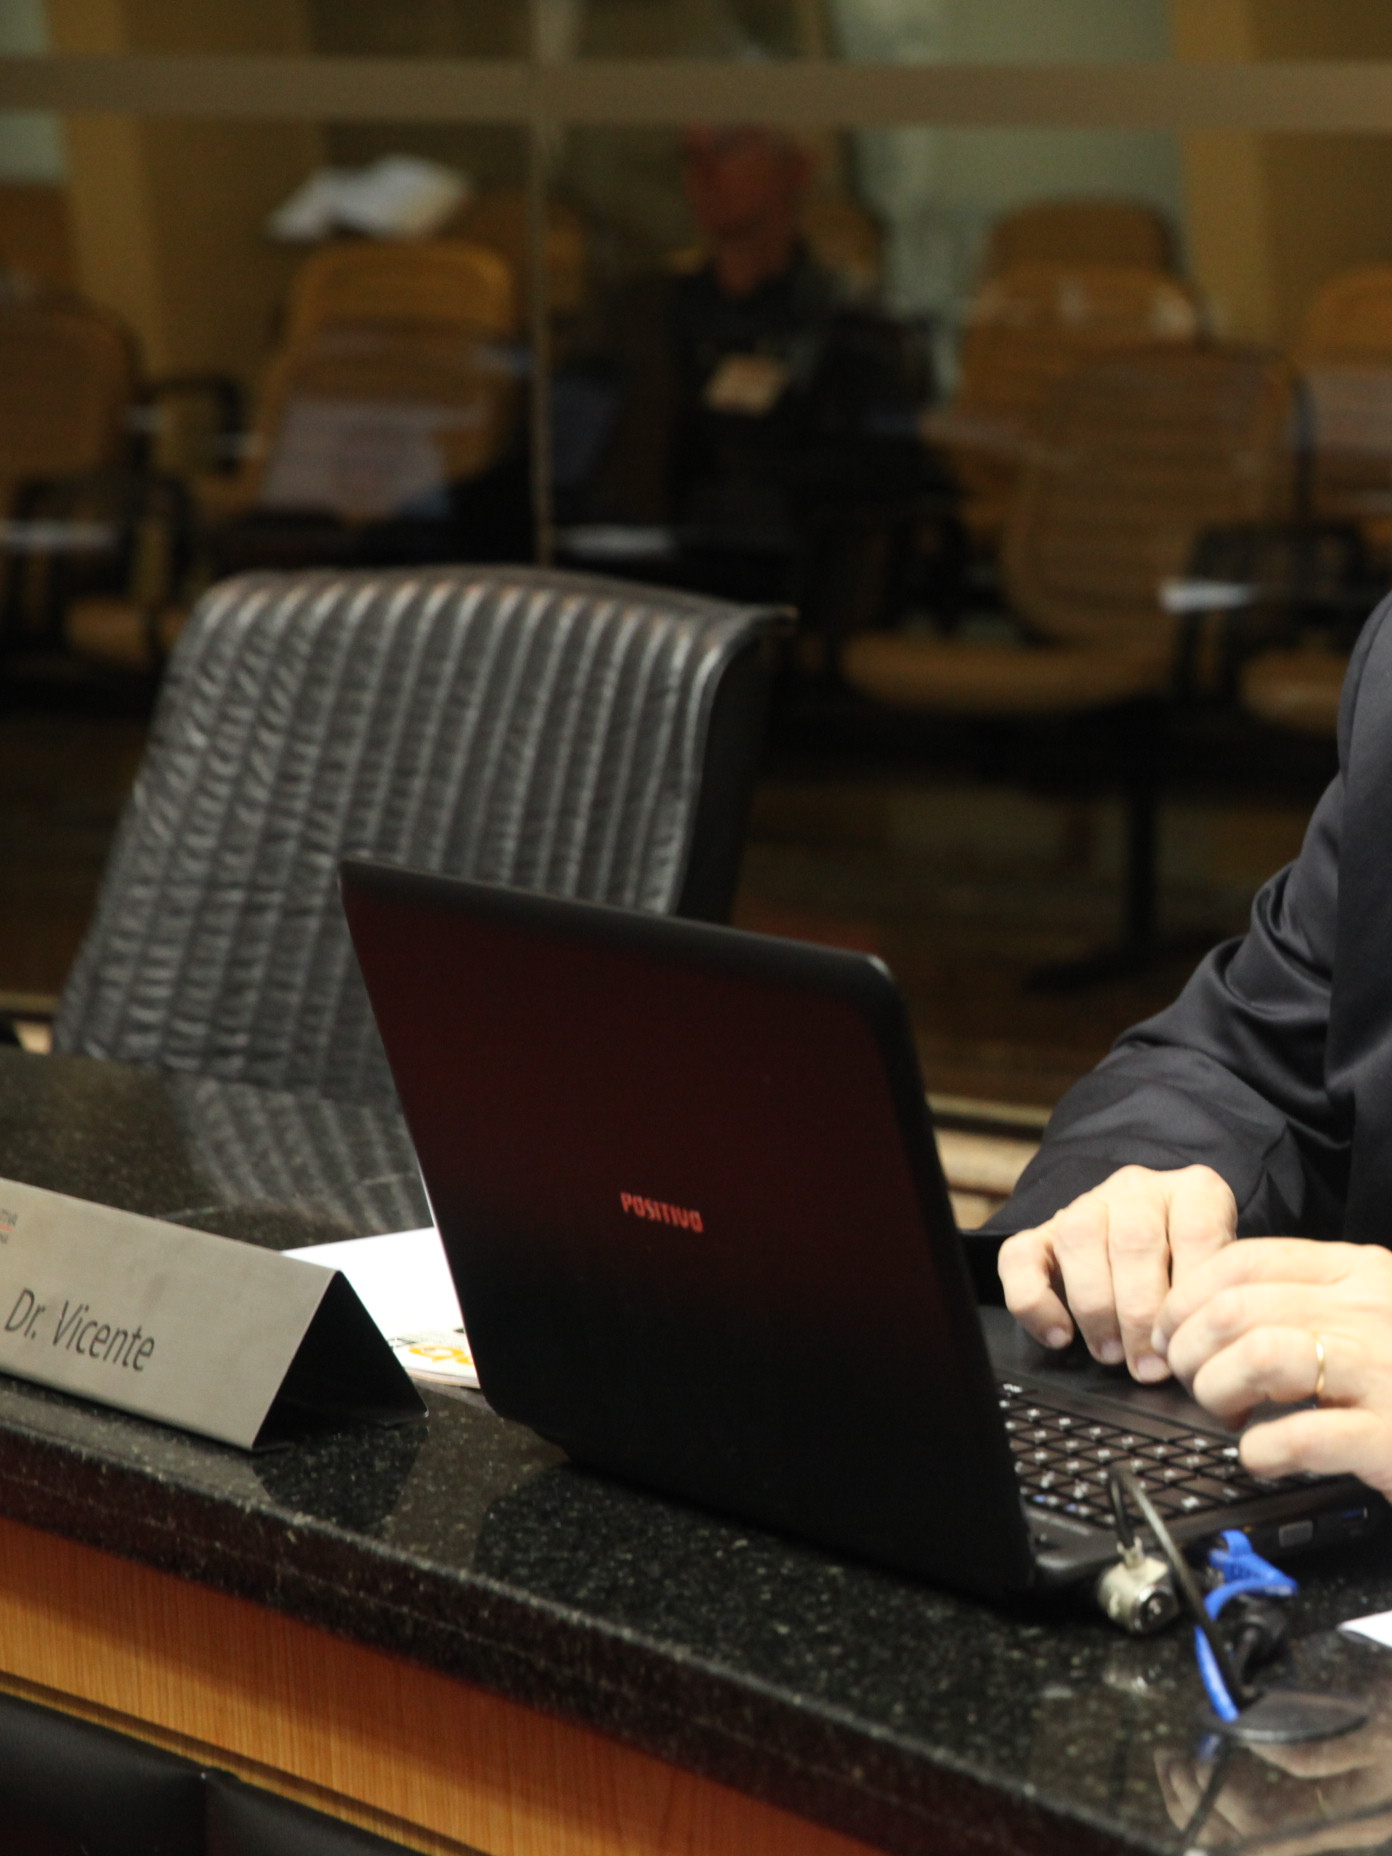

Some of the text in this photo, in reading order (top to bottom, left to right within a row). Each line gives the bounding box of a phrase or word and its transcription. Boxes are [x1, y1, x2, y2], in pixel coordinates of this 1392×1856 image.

[620, 1191, 704, 1233] POSITIVO
[4, 1287, 155, 1371] Dr. Vicente
